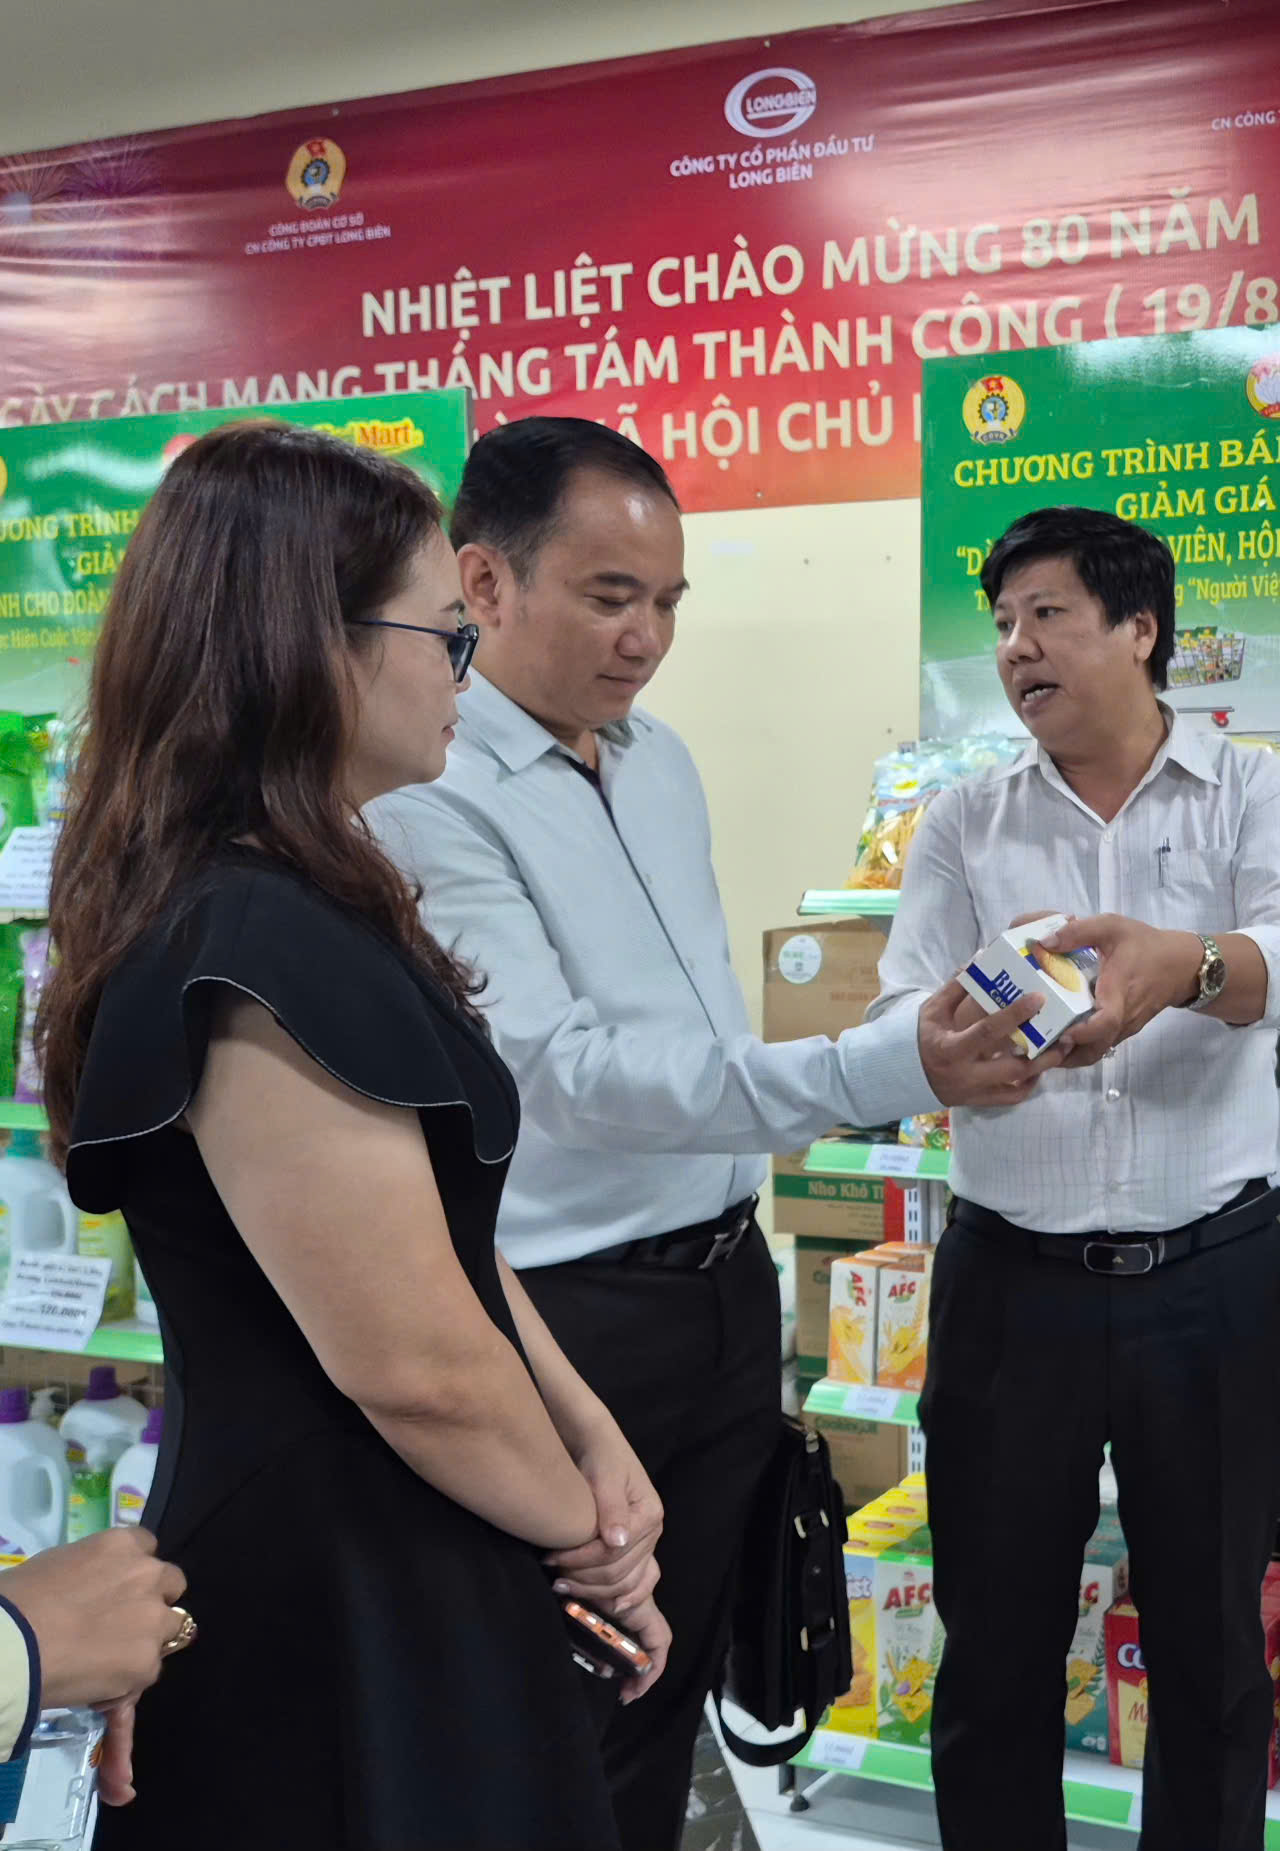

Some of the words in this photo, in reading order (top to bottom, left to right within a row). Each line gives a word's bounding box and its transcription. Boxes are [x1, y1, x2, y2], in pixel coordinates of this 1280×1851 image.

[1212, 117, 1232, 131] CN
[1235, 110, 1275, 128] CÔNG
[670, 155, 715, 178] CÔNG
[717, 153, 738, 171] TY
[739, 142, 763, 169] CỔ
[766, 138, 811, 164] PHẦN
[814, 135, 847, 159] ĐẦU
[851, 134, 876, 153] TƯ
[729, 168, 774, 190] LONG
[776, 161, 814, 185] BIÊN
[361, 265, 511, 342] NHIỆT
[524, 251, 634, 330] LIỆT
[646, 233, 806, 309] CHÀO
[821, 216, 1003, 291] MỪNG
[1018, 212, 1091, 270] 80
[1108, 184, 1262, 259] NĂM
[375, 340, 551, 402] THÁNG
[564, 324, 680, 392] TÁM
[693, 308, 894, 381] THÀNH
[910, 290, 1083, 362] CÔNG
[355, 423, 412, 450] Mart
[661, 393, 760, 471] HỘI
[776, 379, 895, 453] CHỦ
[953, 450, 1094, 488] CHƯƠNG
[1101, 437, 1209, 477] TRÌNH
[1115, 481, 1206, 521] GIẢM
[1214, 475, 1277, 516] GIÁ
[24, 590, 61, 617] CHO
[807, 1180, 838, 1197] Nho
[839, 1182, 869, 1199] Khô
[850, 1270, 868, 1308] AFC
[887, 1280, 917, 1299] AFC
[882, 1581, 932, 1612] AFC
